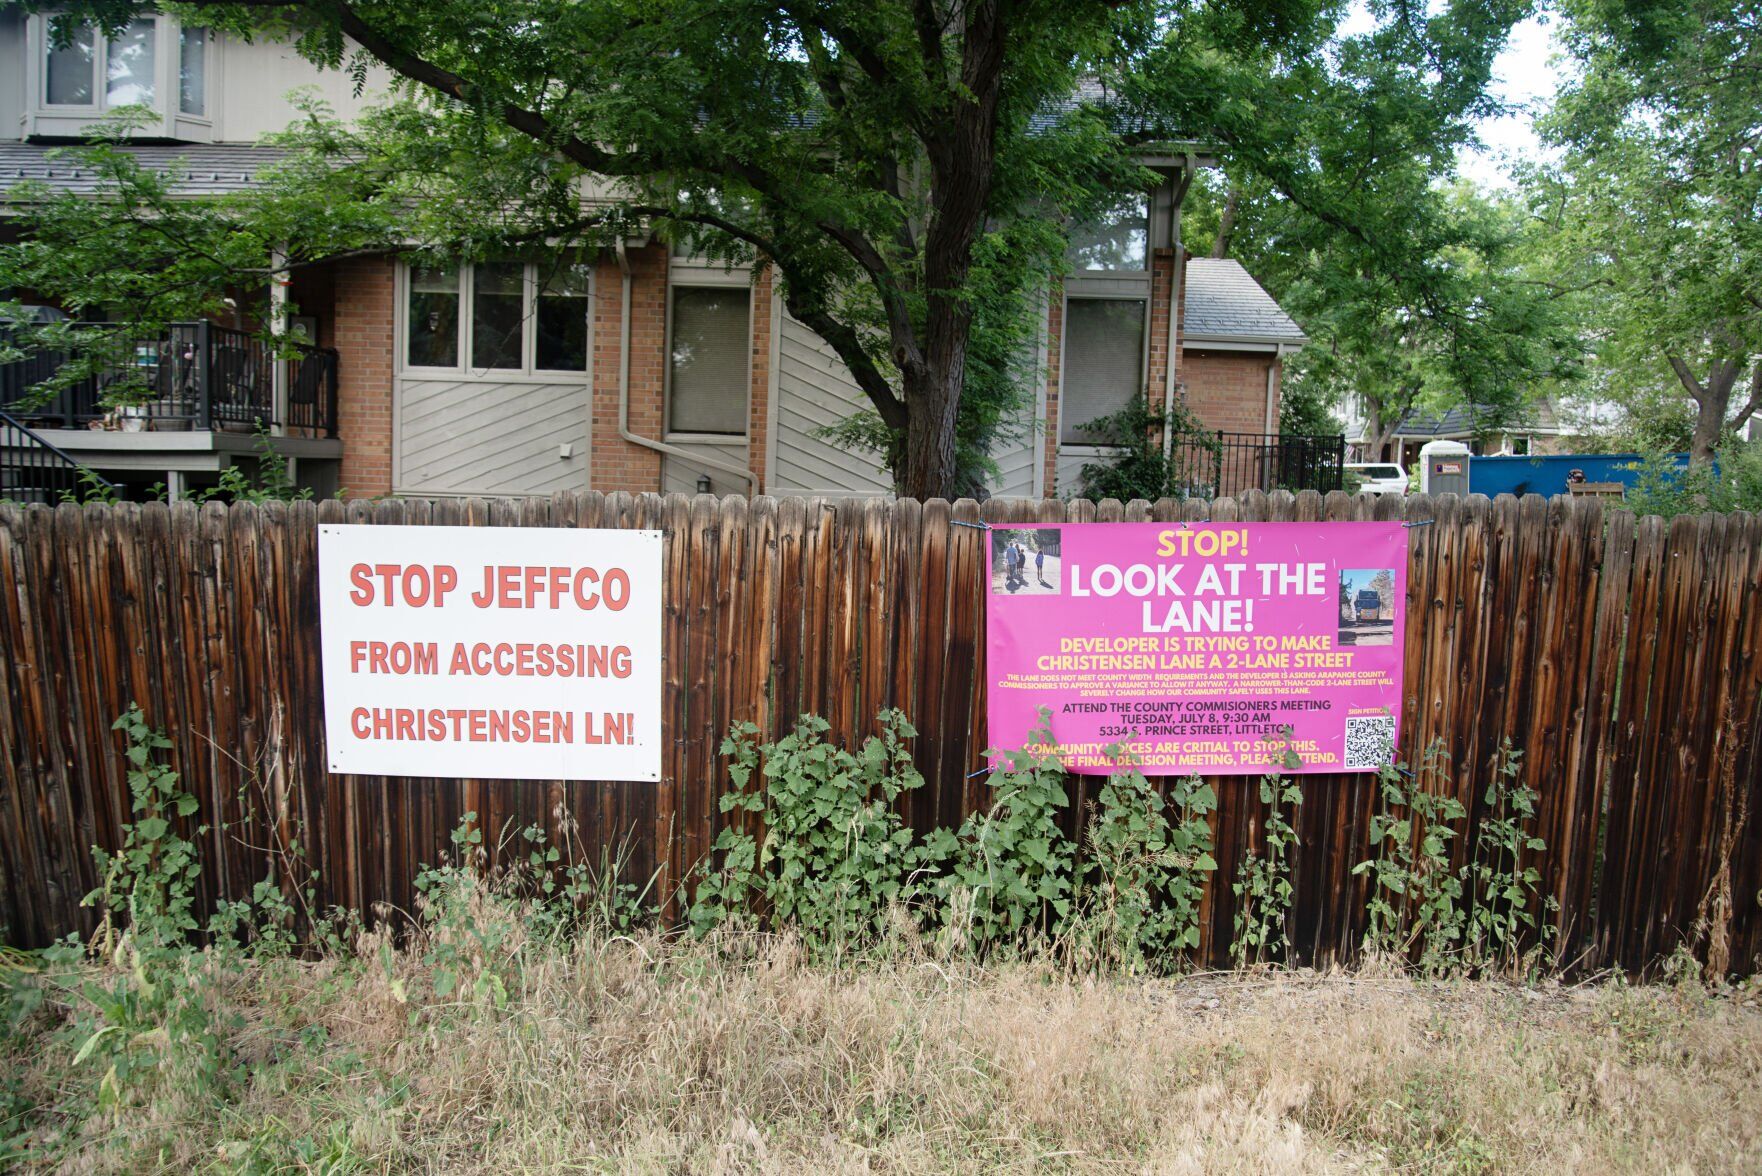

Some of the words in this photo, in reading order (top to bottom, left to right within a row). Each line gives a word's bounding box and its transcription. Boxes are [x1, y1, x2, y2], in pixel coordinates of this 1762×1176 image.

[1156, 529, 1249, 557] STOP!
[349, 563, 458, 609] STOP
[471, 566, 631, 612] JEFFCO
[1071, 564, 1185, 597] LOOK
[1194, 563, 1246, 596] AT
[1256, 563, 1326, 595] THE
[1143, 599, 1254, 633] LANE!
[1060, 637, 1160, 653] DEVELOPER
[1165, 638, 1180, 652] IS
[1185, 636, 1250, 652] TRYING
[1254, 636, 1278, 651] TO
[1282, 636, 1331, 651] MAKE
[350, 640, 438, 675] FROM
[449, 642, 632, 679] ACCESSING
[1037, 656, 1155, 671] CHRISTENSEN
[1161, 655, 1204, 669] LANE
[1209, 654, 1222, 668] A
[1227, 653, 1289, 668] 2-LANE
[1294, 653, 1354, 668] STREET
[998, 681, 1058, 689] COMMISSIONERS
[1062, 703, 1107, 713] ATTEND
[1109, 702, 1131, 713] THE
[1134, 701, 1183, 713] COUNTY
[1186, 701, 1277, 711] COMMISIONERS
[1281, 700, 1331, 710] MEETING
[351, 707, 574, 744] CHRISTENSEN
[585, 712, 635, 746] LN!
[1120, 714, 1175, 725] TUESDAY,
[1178, 714, 1205, 723] JULY
[1208, 714, 1219, 724] 8,
[1223, 713, 1249, 722] 9:30
[1251, 713, 1271, 722] AM
[1100, 726, 1128, 736] 5334
[1145, 726, 1186, 736] PRINCE
[1191, 725, 1232, 736] STREET,
[1155, 743, 1180, 753] ARE
[1183, 742, 1230, 753] CRITIAL
[1233, 742, 1250, 752] TO
[1253, 741, 1286, 752] STOP
[1290, 740, 1320, 751] THIS.
[1077, 756, 1113, 766] FINAL
[1179, 754, 1237, 766] MEETING,
